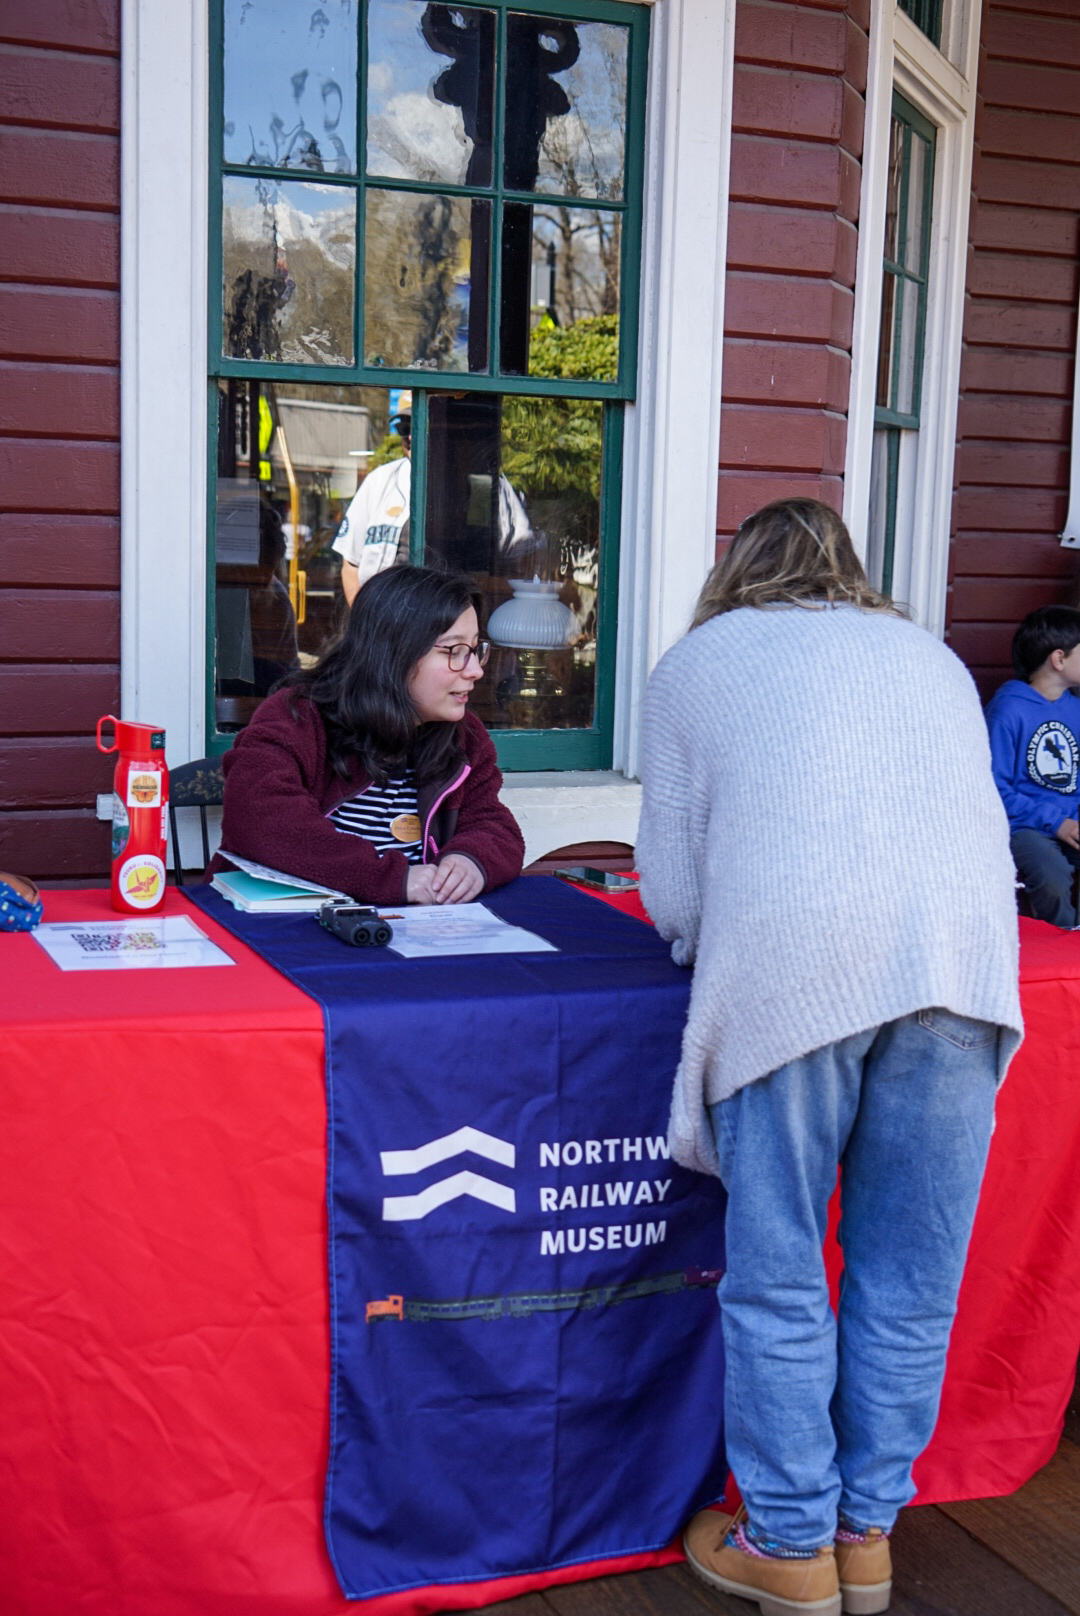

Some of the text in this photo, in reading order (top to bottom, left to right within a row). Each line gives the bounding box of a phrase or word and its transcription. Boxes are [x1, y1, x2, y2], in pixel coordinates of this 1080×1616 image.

[1027, 721, 1080, 762] OLYMPIC CHRISTIAN
[539, 1136, 670, 1167] NORTHW
[539, 1179, 672, 1212] RAILWAY
[540, 1221, 667, 1255] MUSEUM
